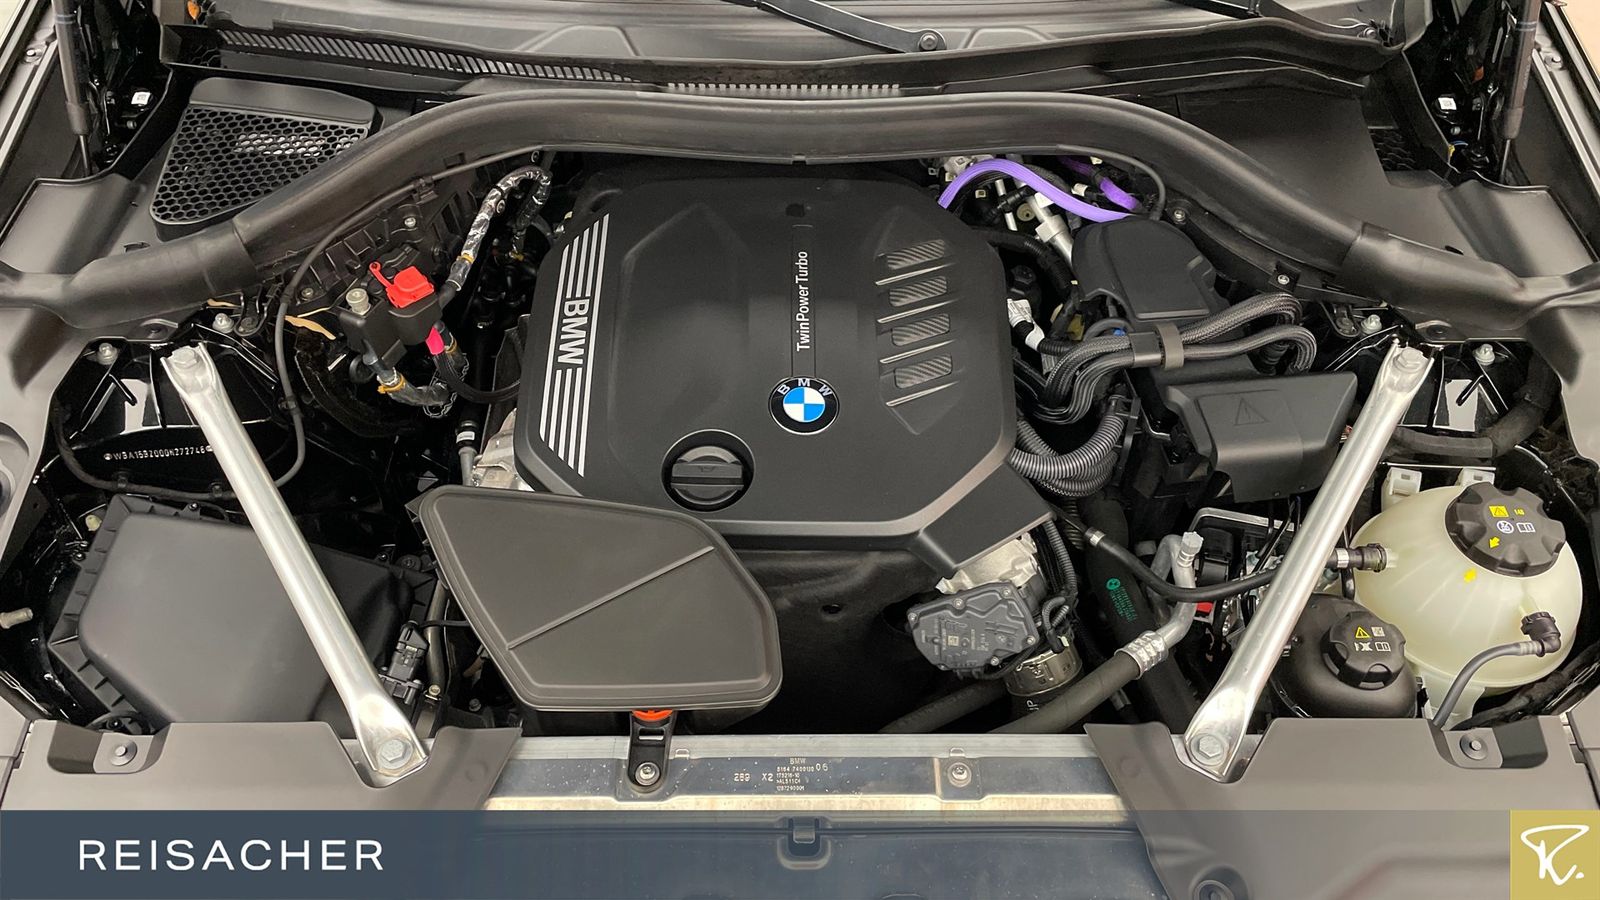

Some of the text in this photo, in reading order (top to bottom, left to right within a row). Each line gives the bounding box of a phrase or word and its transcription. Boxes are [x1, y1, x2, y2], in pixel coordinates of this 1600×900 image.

[795, 251, 811, 352] TwinPower Turbo
[557, 298, 590, 365] BMW
[777, 378, 833, 397] BMW
[762, 773, 774, 782] X2
